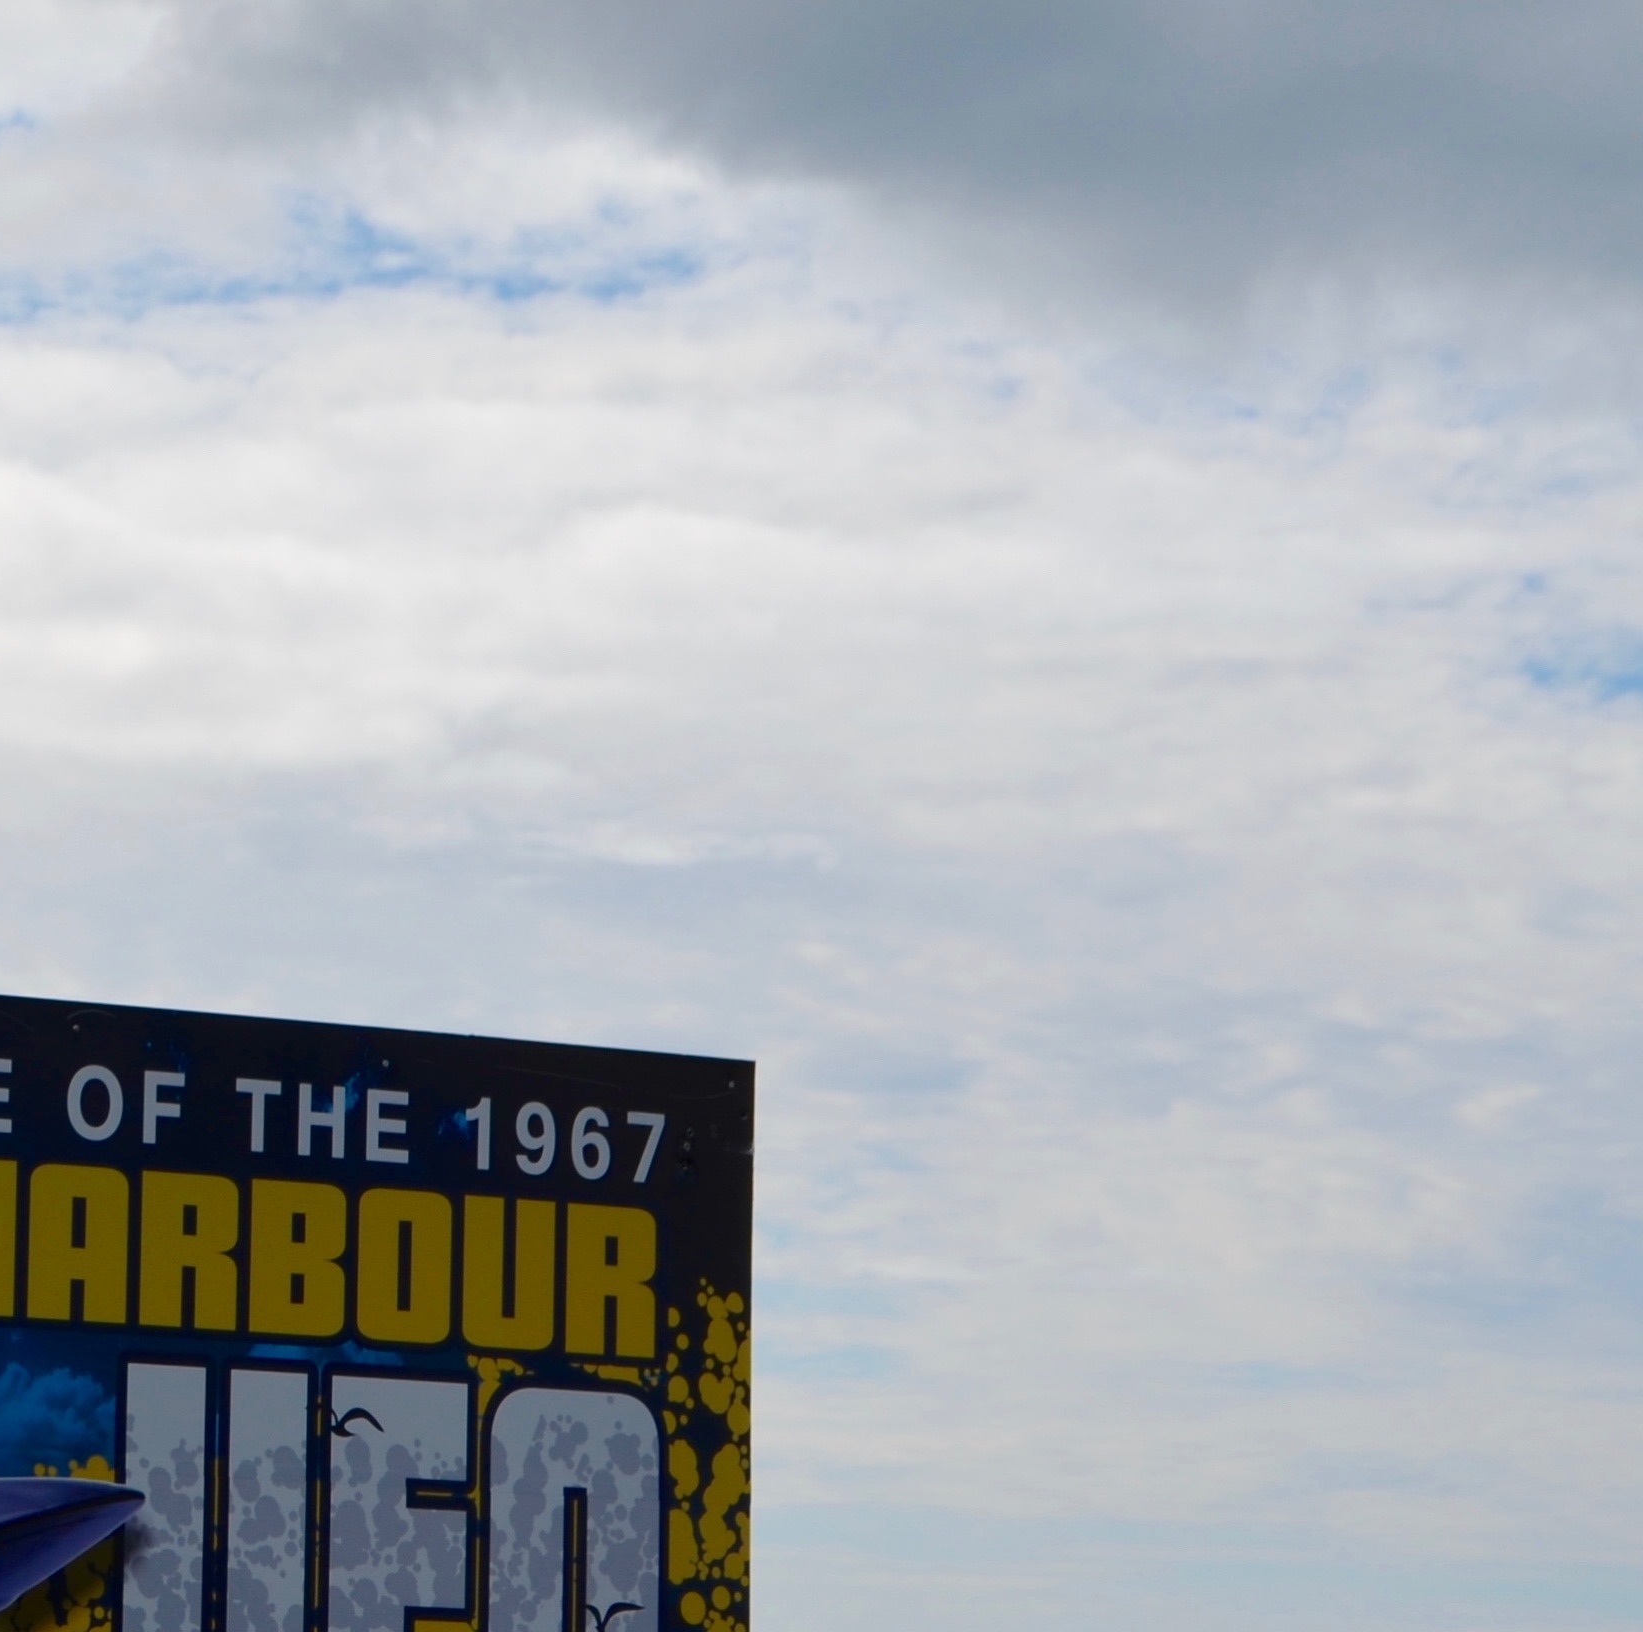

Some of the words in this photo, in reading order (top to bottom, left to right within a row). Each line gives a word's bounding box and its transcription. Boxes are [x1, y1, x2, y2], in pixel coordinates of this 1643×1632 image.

[64, 1064, 186, 1145] OF
[235, 1077, 412, 1165] THE
[465, 1096, 667, 1184] 1967
